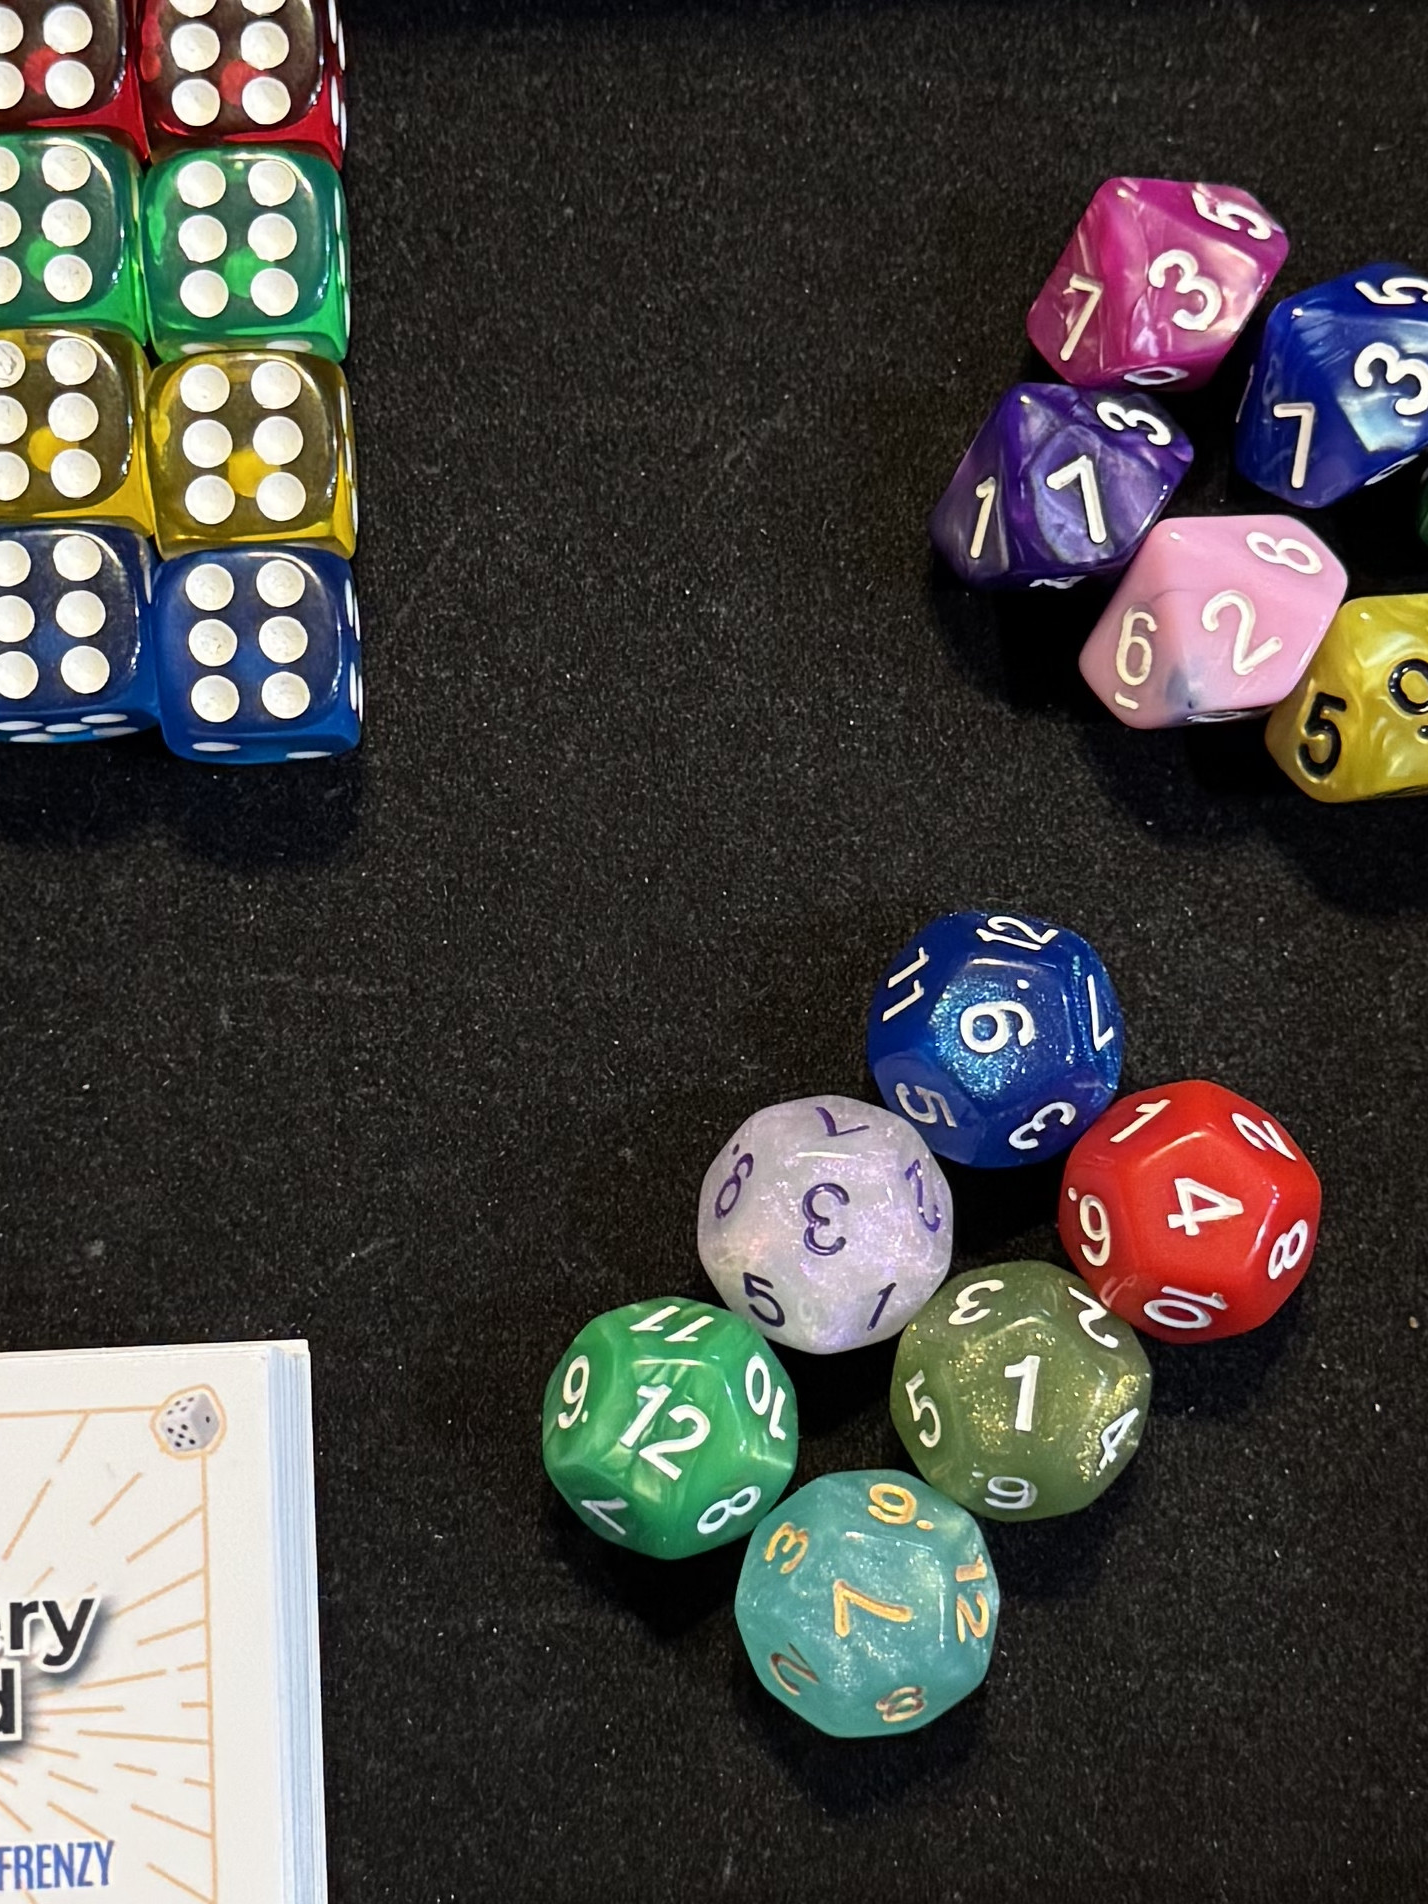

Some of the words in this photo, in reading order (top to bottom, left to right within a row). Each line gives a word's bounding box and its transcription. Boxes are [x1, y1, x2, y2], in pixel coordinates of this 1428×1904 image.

[1192, 189, 1271, 240] 5
[1060, 274, 1102, 361] 7
[1148, 249, 1221, 331] 3
[1097, 402, 1171, 445] 3
[1273, 402, 1315, 488] 7
[971, 477, 996, 559] 1
[1046, 455, 1106, 543] 7
[1246, 531, 1323, 575] 8
[1202, 590, 1282, 676] 2
[1298, 692, 1347, 780] 5
[976, 916, 1058, 950] 12
[883, 947, 929, 1022] 11
[1087, 974, 1114, 1051] 7
[815, 1107, 870, 1137] 7
[895, 1083, 957, 1127] 5
[1008, 1102, 1076, 1149] 3
[1109, 1099, 1171, 1143] 1
[1231, 1113, 1297, 1161] 2
[802, 1183, 850, 1256] 3
[1167, 1177, 1244, 1236] 4
[1268, 1220, 1308, 1279] 8
[629, 1306, 714, 1342] 11
[743, 1272, 785, 1328] 5
[867, 1283, 896, 1330] 1
[948, 1279, 1004, 1326] 3
[1068, 1286, 1119, 1348] 2
[1144, 1286, 1228, 1329] 10
[745, 1352, 786, 1440] 10
[905, 1370, 941, 1448] 5
[1004, 1355, 1040, 1431] 1
[620, 1384, 710, 1480] 12
[1096, 1408, 1139, 1474] 4
[581, 1497, 629, 1535] 7
[697, 1486, 761, 1534] 8
[764, 1522, 808, 1574] 3
[833, 1579, 913, 1638] 7
[955, 1554, 989, 1643] 12
